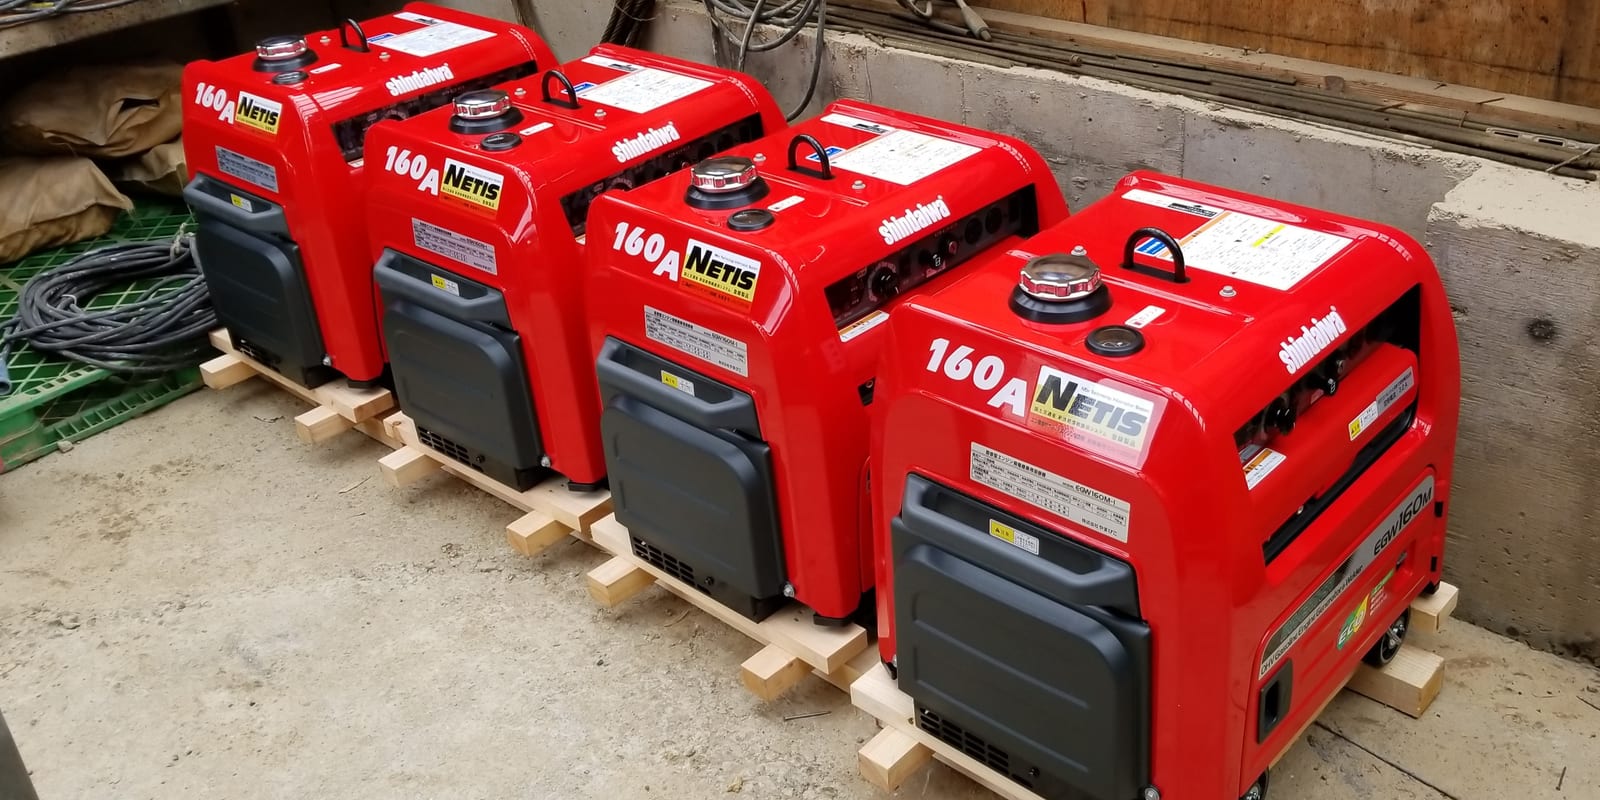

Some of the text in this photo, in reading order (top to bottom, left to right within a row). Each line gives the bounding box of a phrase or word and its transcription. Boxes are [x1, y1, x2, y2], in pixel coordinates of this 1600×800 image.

[195, 82, 235, 124] 160A
[385, 65, 452, 97] shindaiwa
[238, 97, 278, 126] NETIS
[611, 123, 679, 163] shindaiwa
[385, 146, 439, 196] 160A
[444, 164, 499, 201] NETIS
[878, 196, 950, 245] shindaiwa
[613, 222, 680, 282] 160A
[685, 245, 756, 291] NETIS
[1279, 307, 1347, 374] shindaiwa
[926, 337, 1027, 417] 160A
[1036, 374, 1148, 436] NETIS
[1374, 487, 1431, 556] EGW160M
